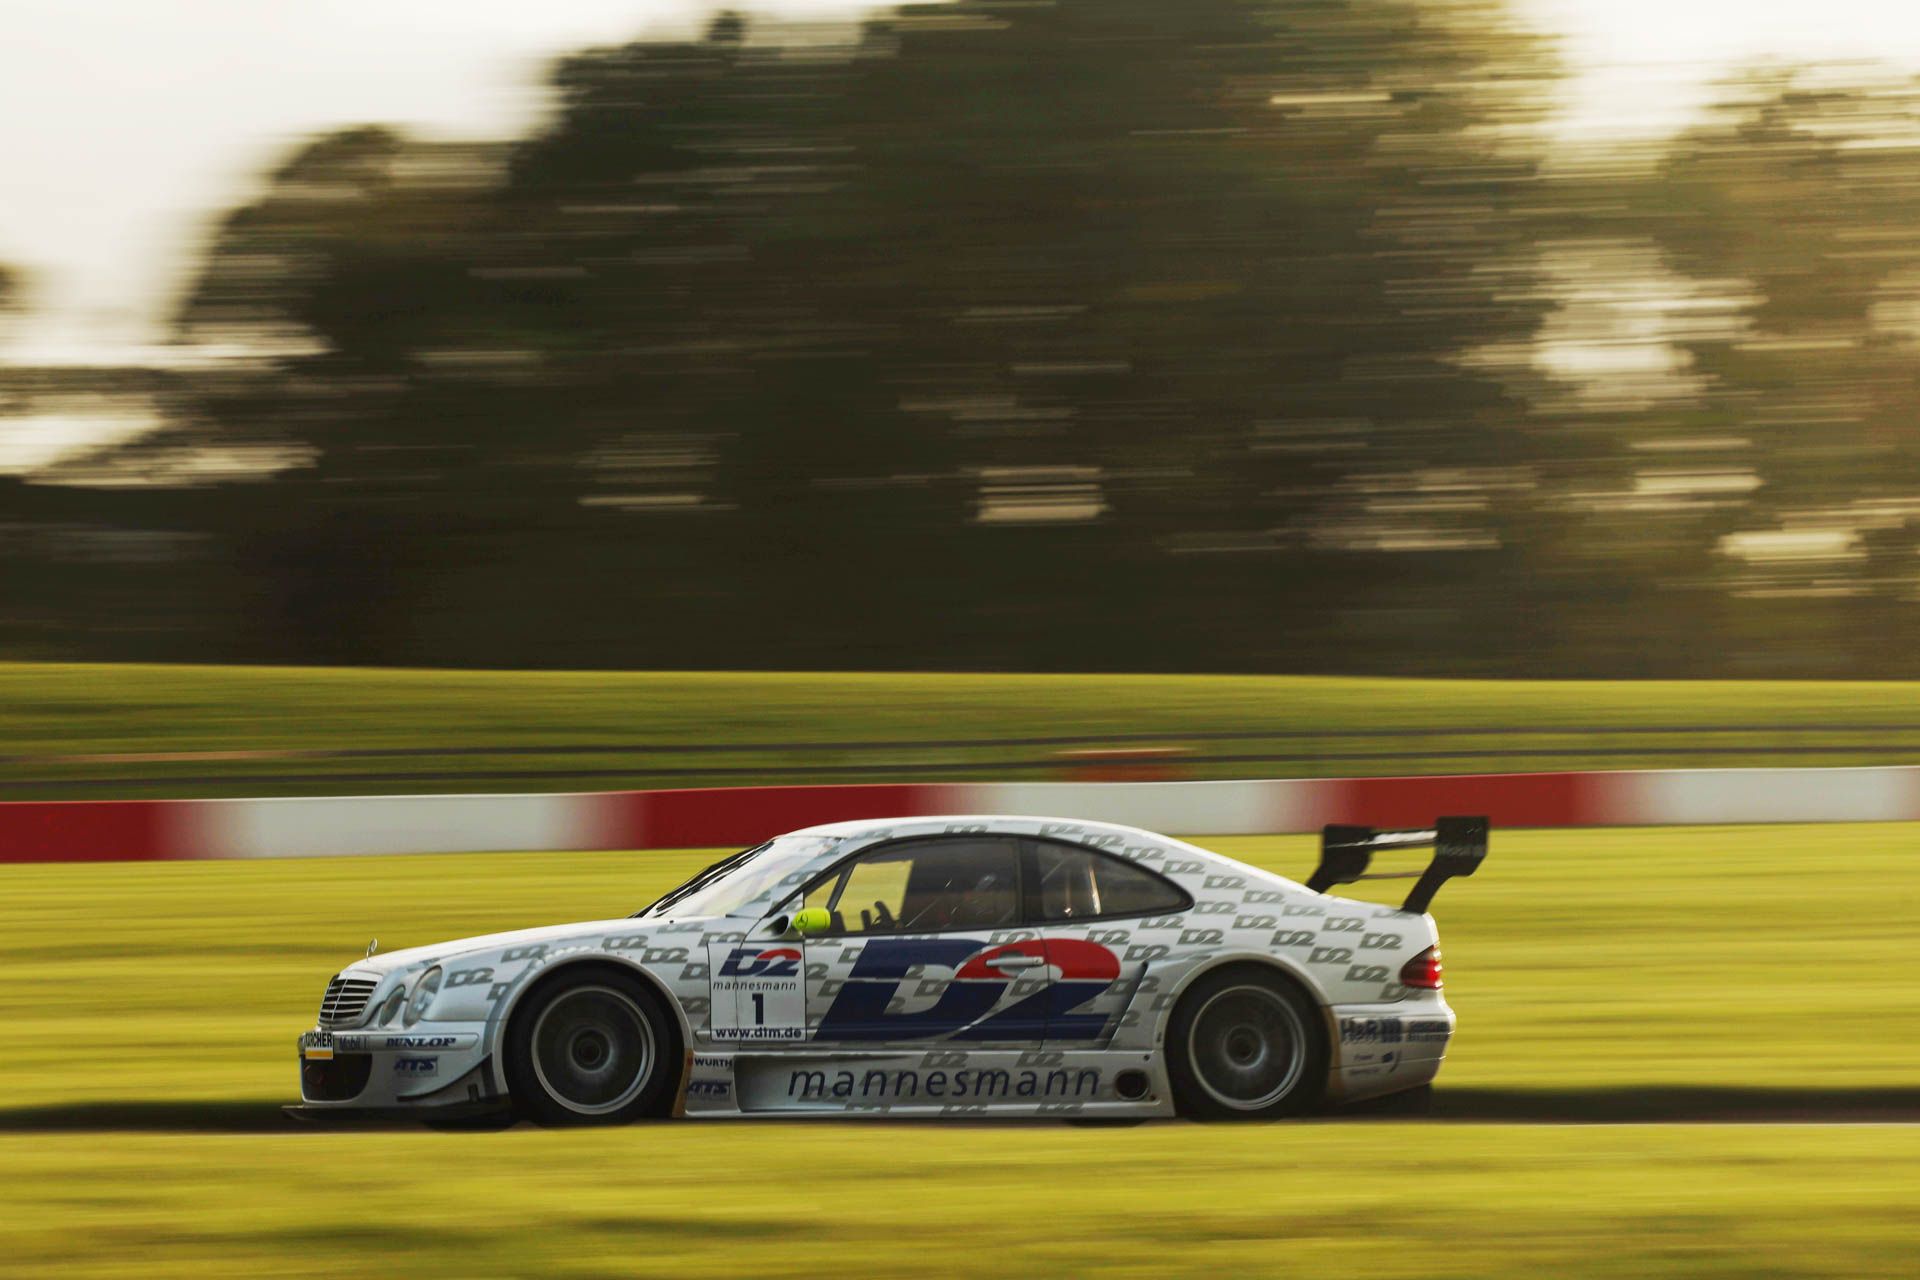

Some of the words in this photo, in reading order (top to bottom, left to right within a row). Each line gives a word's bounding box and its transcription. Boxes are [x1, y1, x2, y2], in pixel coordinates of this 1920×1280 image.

[1161, 861, 1206, 874] D2
[1202, 875, 1247, 889] D2
[1241, 890, 1286, 904] D2
[1192, 901, 1238, 914] D2
[1281, 904, 1327, 917] D2
[1232, 915, 1278, 929] D2
[1322, 917, 1366, 932] D2
[601, 935, 650, 950] D2
[1177, 929, 1224, 945] D2
[1269, 930, 1317, 946] D2
[1358, 933, 1403, 950] D2
[640, 947, 690, 964] D2
[1122, 945, 1170, 961] D2
[1306, 947, 1355, 964] D2
[718, 948, 802, 977] D2
[444, 967, 496, 988] D2
[1344, 965, 1390, 982] D2
[713, 981, 797, 991] mannesmann
[811, 938, 1121, 1041] D2
[752, 993, 764, 1025] 1
[716, 1027, 802, 1039] www.dtm.de
[385, 1037, 457, 1047] DUNLOP
[918, 1052, 970, 1069] D2
[1015, 1051, 1064, 1068] D2
[788, 1069, 1100, 1097] mannesmann
